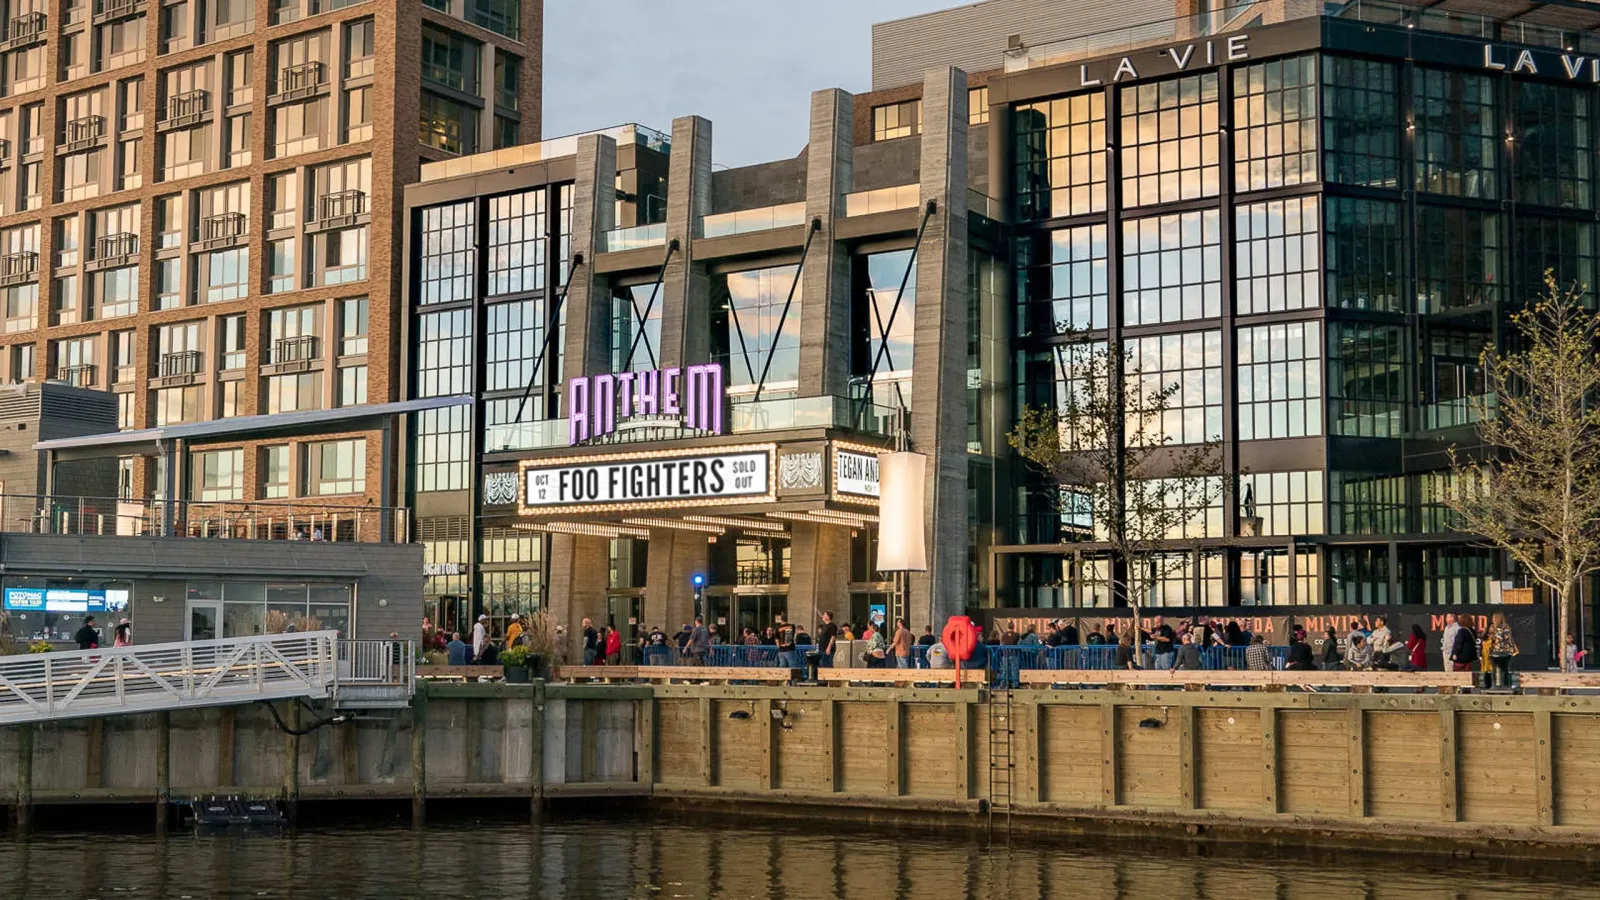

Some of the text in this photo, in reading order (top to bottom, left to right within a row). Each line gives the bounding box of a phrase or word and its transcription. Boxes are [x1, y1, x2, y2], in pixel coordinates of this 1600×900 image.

[1081, 35, 1249, 86] LA VIE
[1484, 44, 1538, 73] LA
[569, 364, 723, 446] ANTHEM
[732, 459, 756, 474] SOLD
[839, 455, 863, 480] TEGAN
[535, 474, 549, 486] OCT
[559, 459, 725, 501] FOO FIGHTERS
[735, 476, 753, 489] OUT
[538, 489, 546, 500] 12
